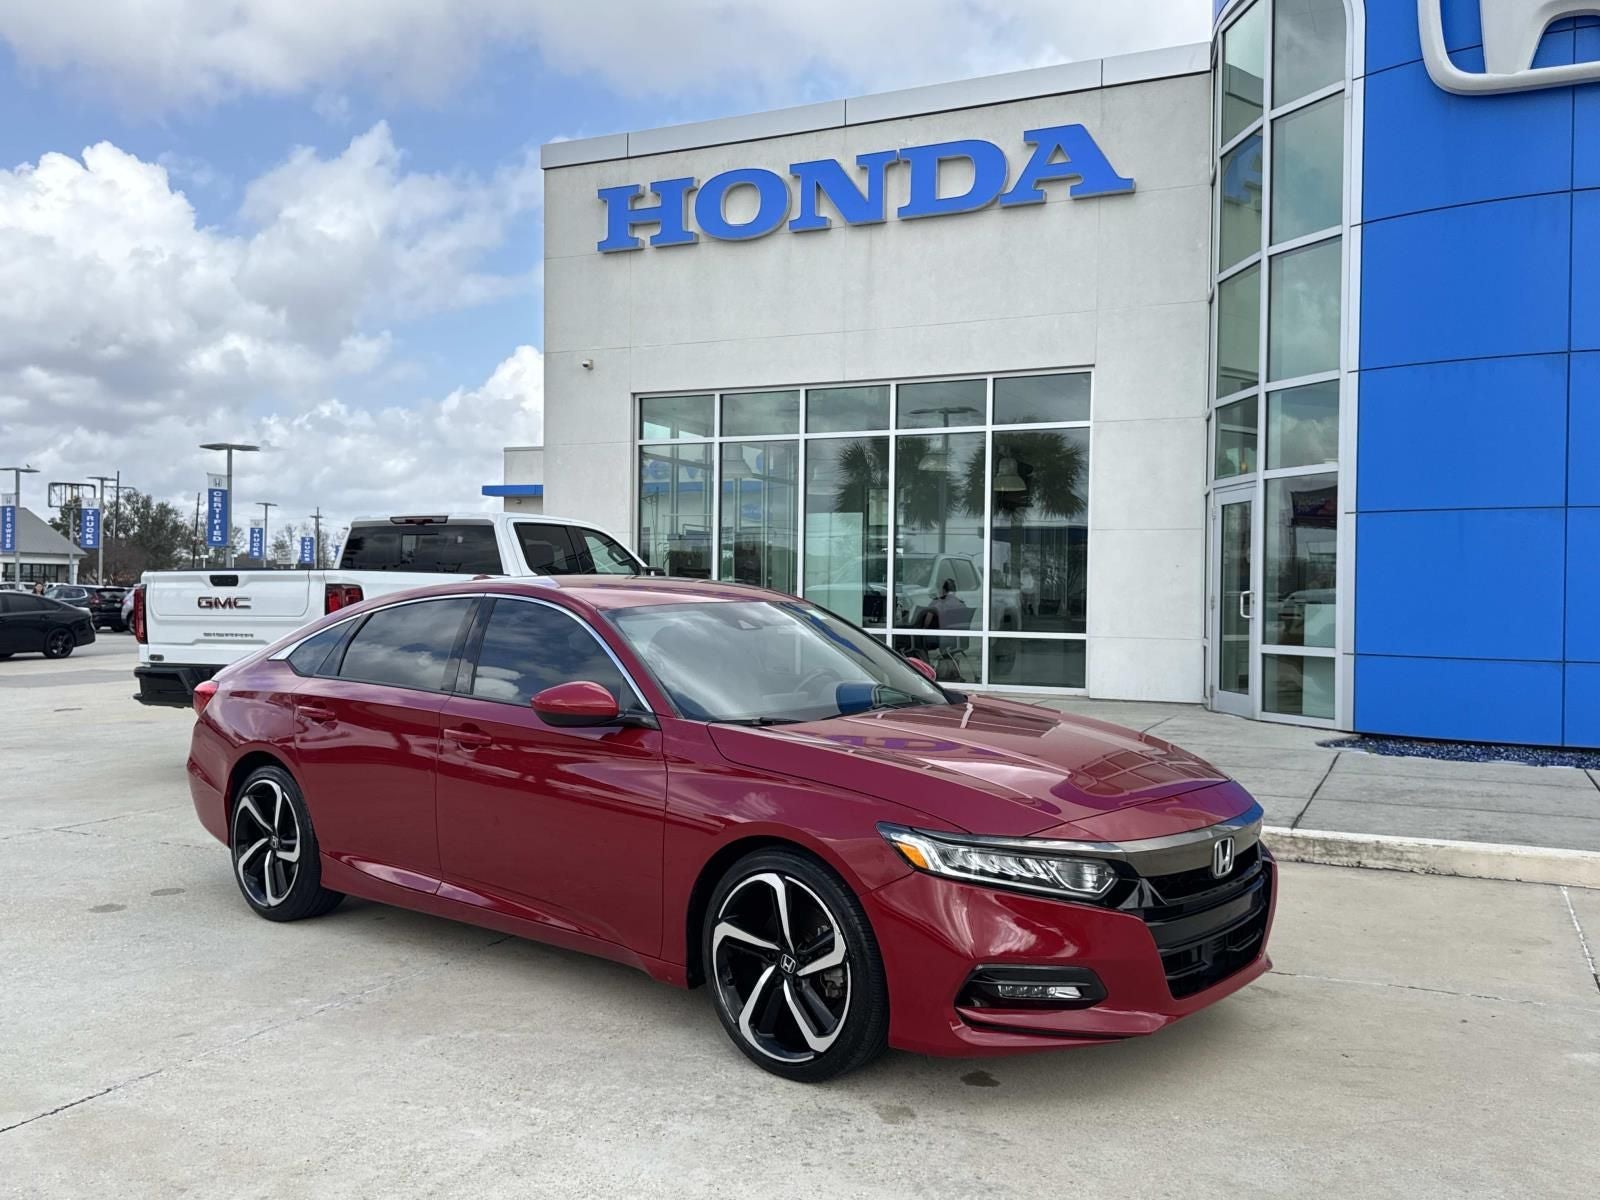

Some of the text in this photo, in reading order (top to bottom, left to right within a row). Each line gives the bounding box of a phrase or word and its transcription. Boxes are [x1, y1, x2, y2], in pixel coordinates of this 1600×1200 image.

[597, 123, 1135, 253] HONDA
[85, 509, 95, 546] TRUCKS
[212, 490, 223, 542] CERTIFIED
[252, 528, 261, 557] TRUCKS
[197, 596, 252, 610] GMC
